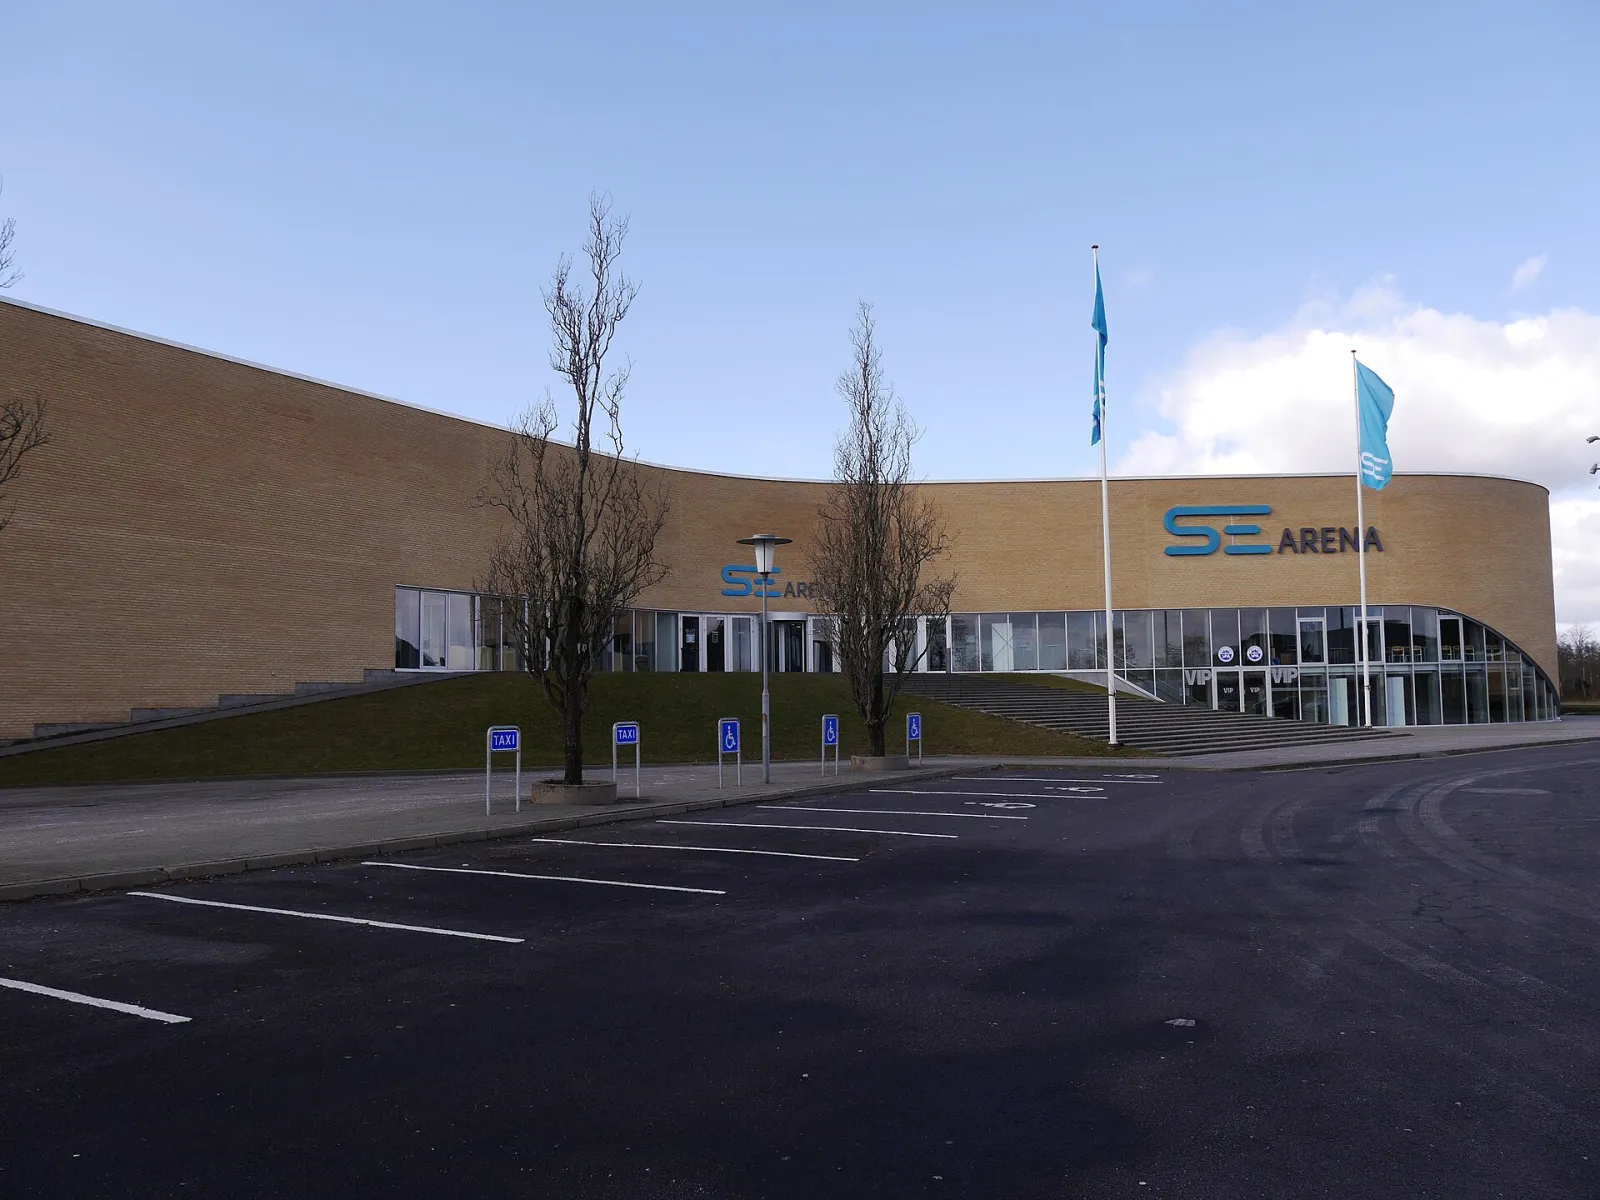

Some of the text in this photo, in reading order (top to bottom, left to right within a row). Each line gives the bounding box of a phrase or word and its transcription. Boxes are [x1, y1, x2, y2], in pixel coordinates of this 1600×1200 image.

[1163, 504, 1384, 556] SE ARENA
[721, 565, 781, 597] SE
[1184, 669, 1212, 685] VIP
[1271, 667, 1298, 684] VIP
[493, 734, 515, 746] TAXI
[617, 729, 636, 740] TAXI
